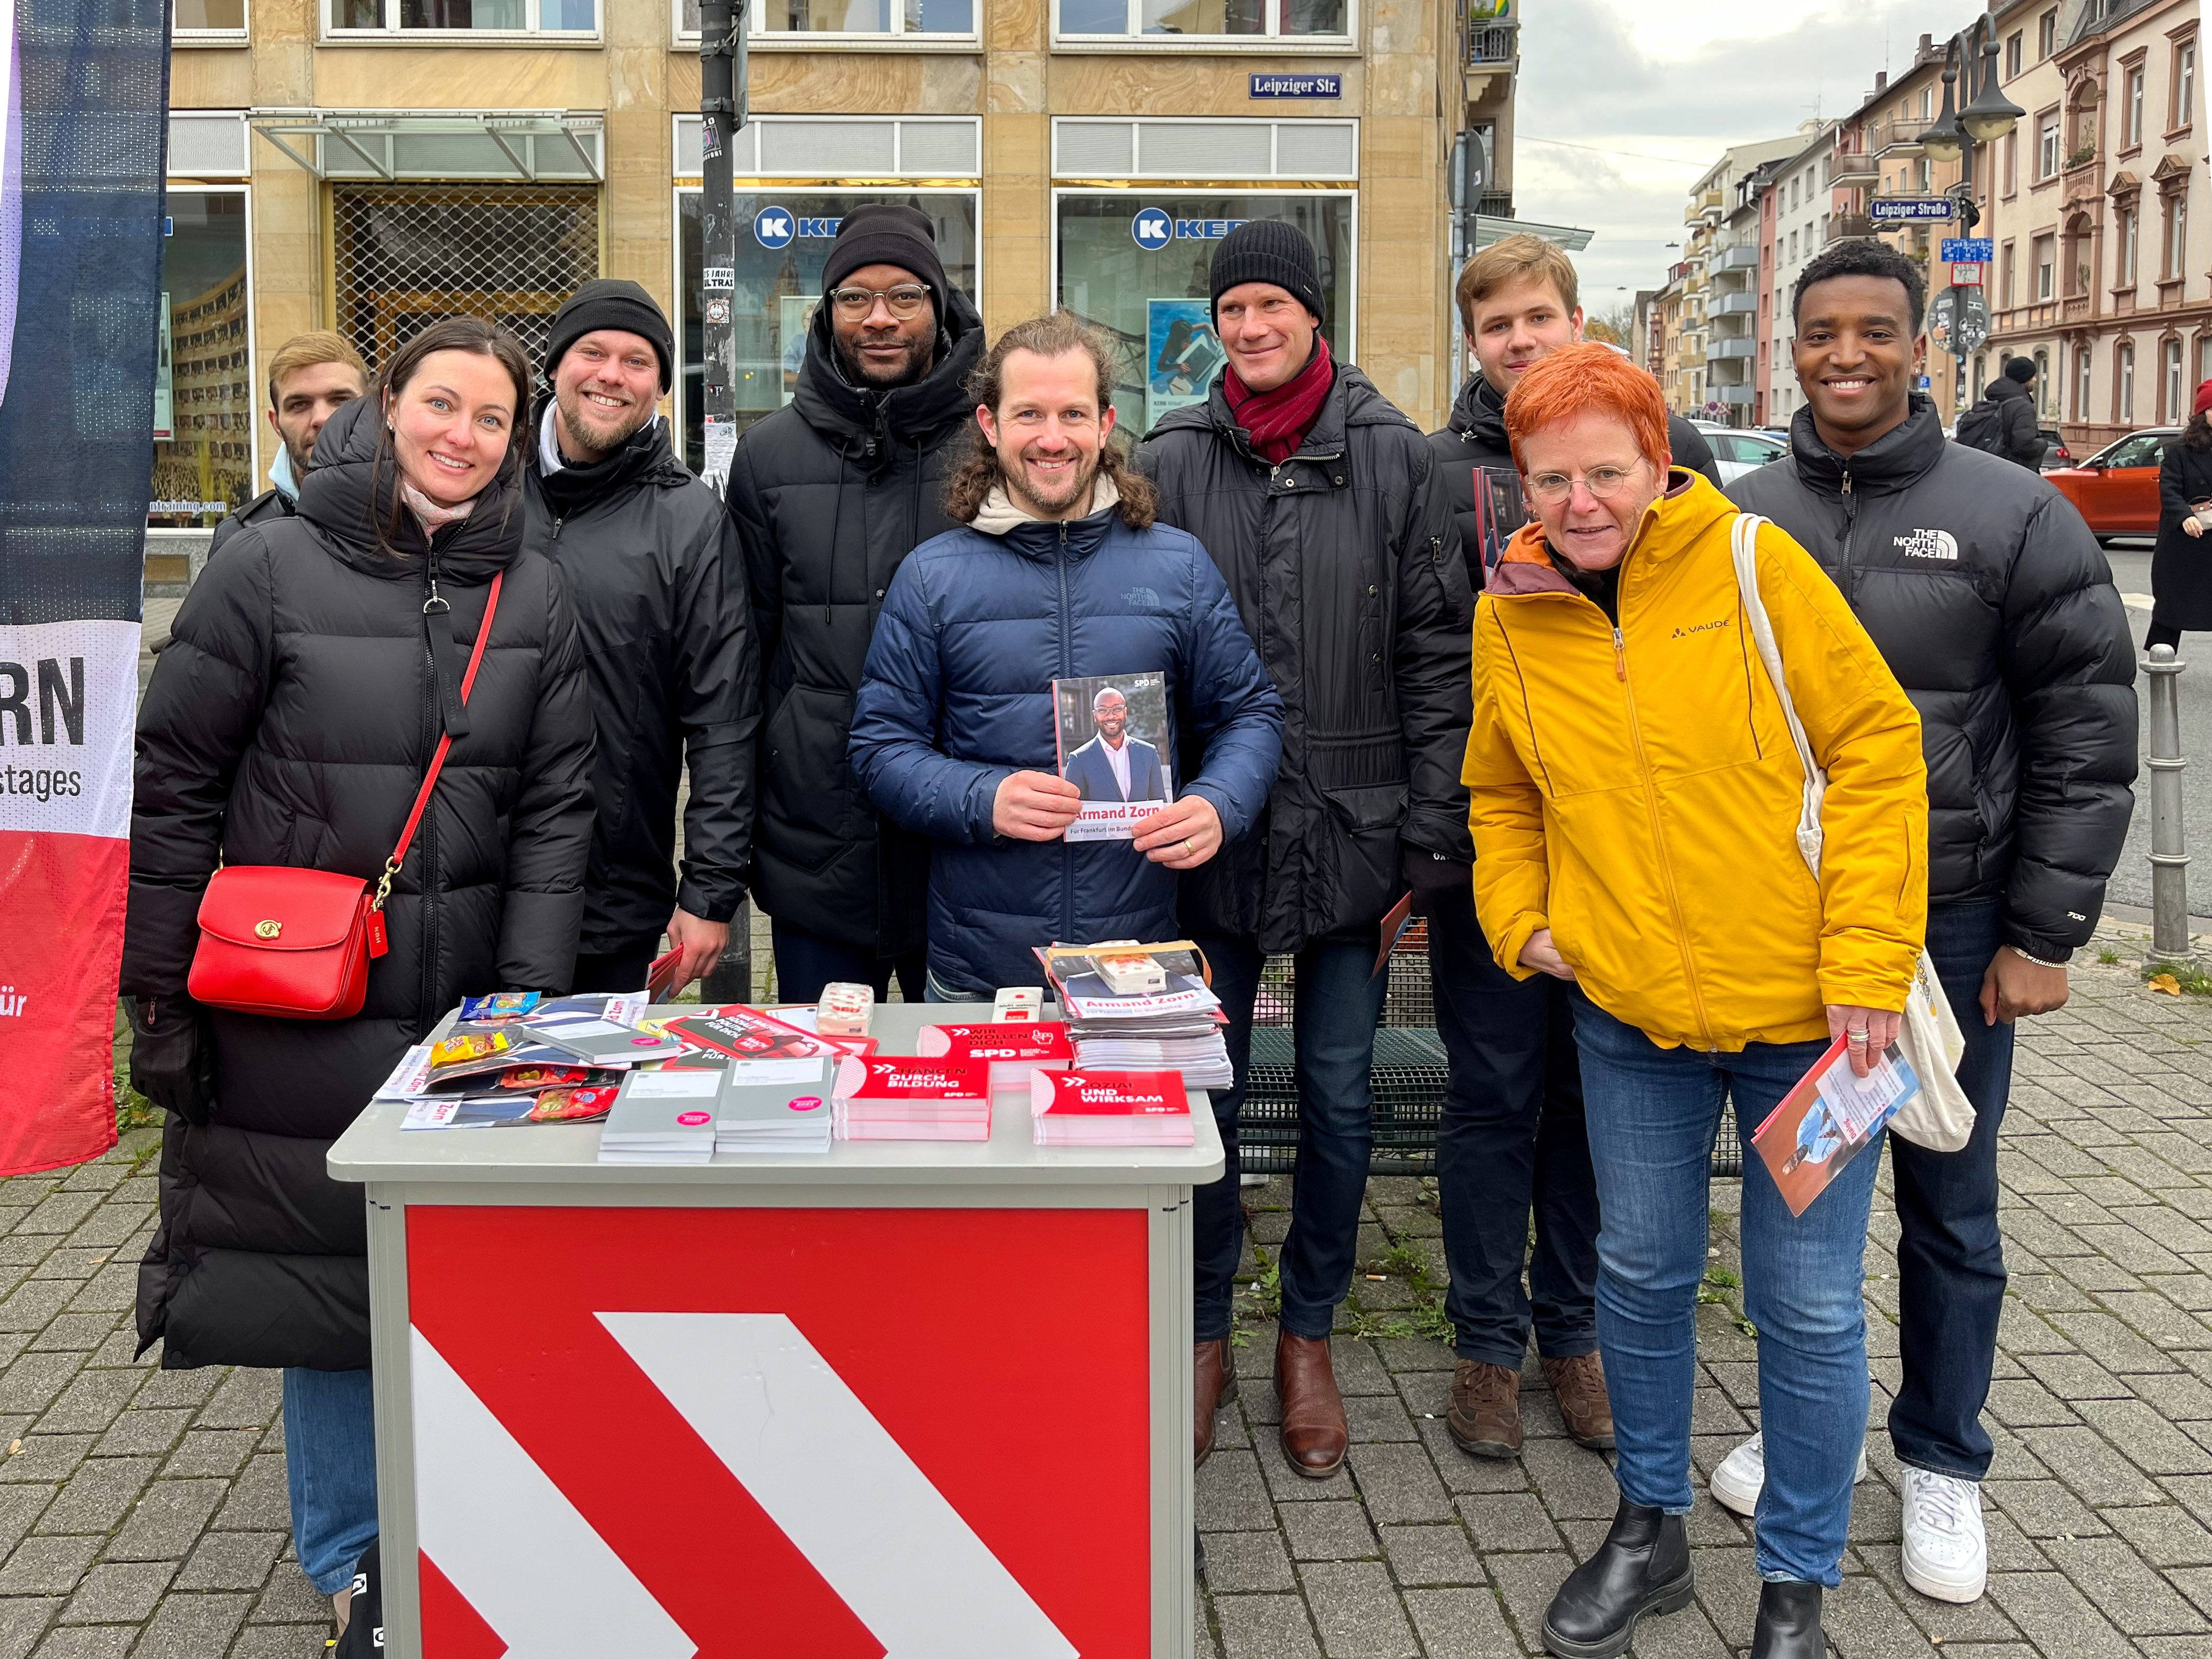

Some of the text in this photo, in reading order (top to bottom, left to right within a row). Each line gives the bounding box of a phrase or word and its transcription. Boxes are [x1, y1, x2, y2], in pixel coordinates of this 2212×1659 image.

[1254, 77, 1337, 95] Leipziger Str.
[1876, 202, 1946, 218] Leipziger Straße
[1913, 528, 1938, 539] THE
[1893, 536, 1936, 549] NORTH
[1905, 546, 1936, 558] FACE
[1688, 619, 1730, 633] VAUDE
[1134, 679, 1150, 687] SPD
[0, 764, 81, 803] tages
[1086, 992, 1195, 1008] Armand Zorn
[608, 1001, 625, 1014] Zorn
[704, 1021, 723, 1030] FÜR
[969, 1048, 1016, 1058] SPD
[405, 1077, 426, 1093] Zorn
[432, 1104, 455, 1120] Zorn
[1843, 1118, 1858, 1139] Dialog
